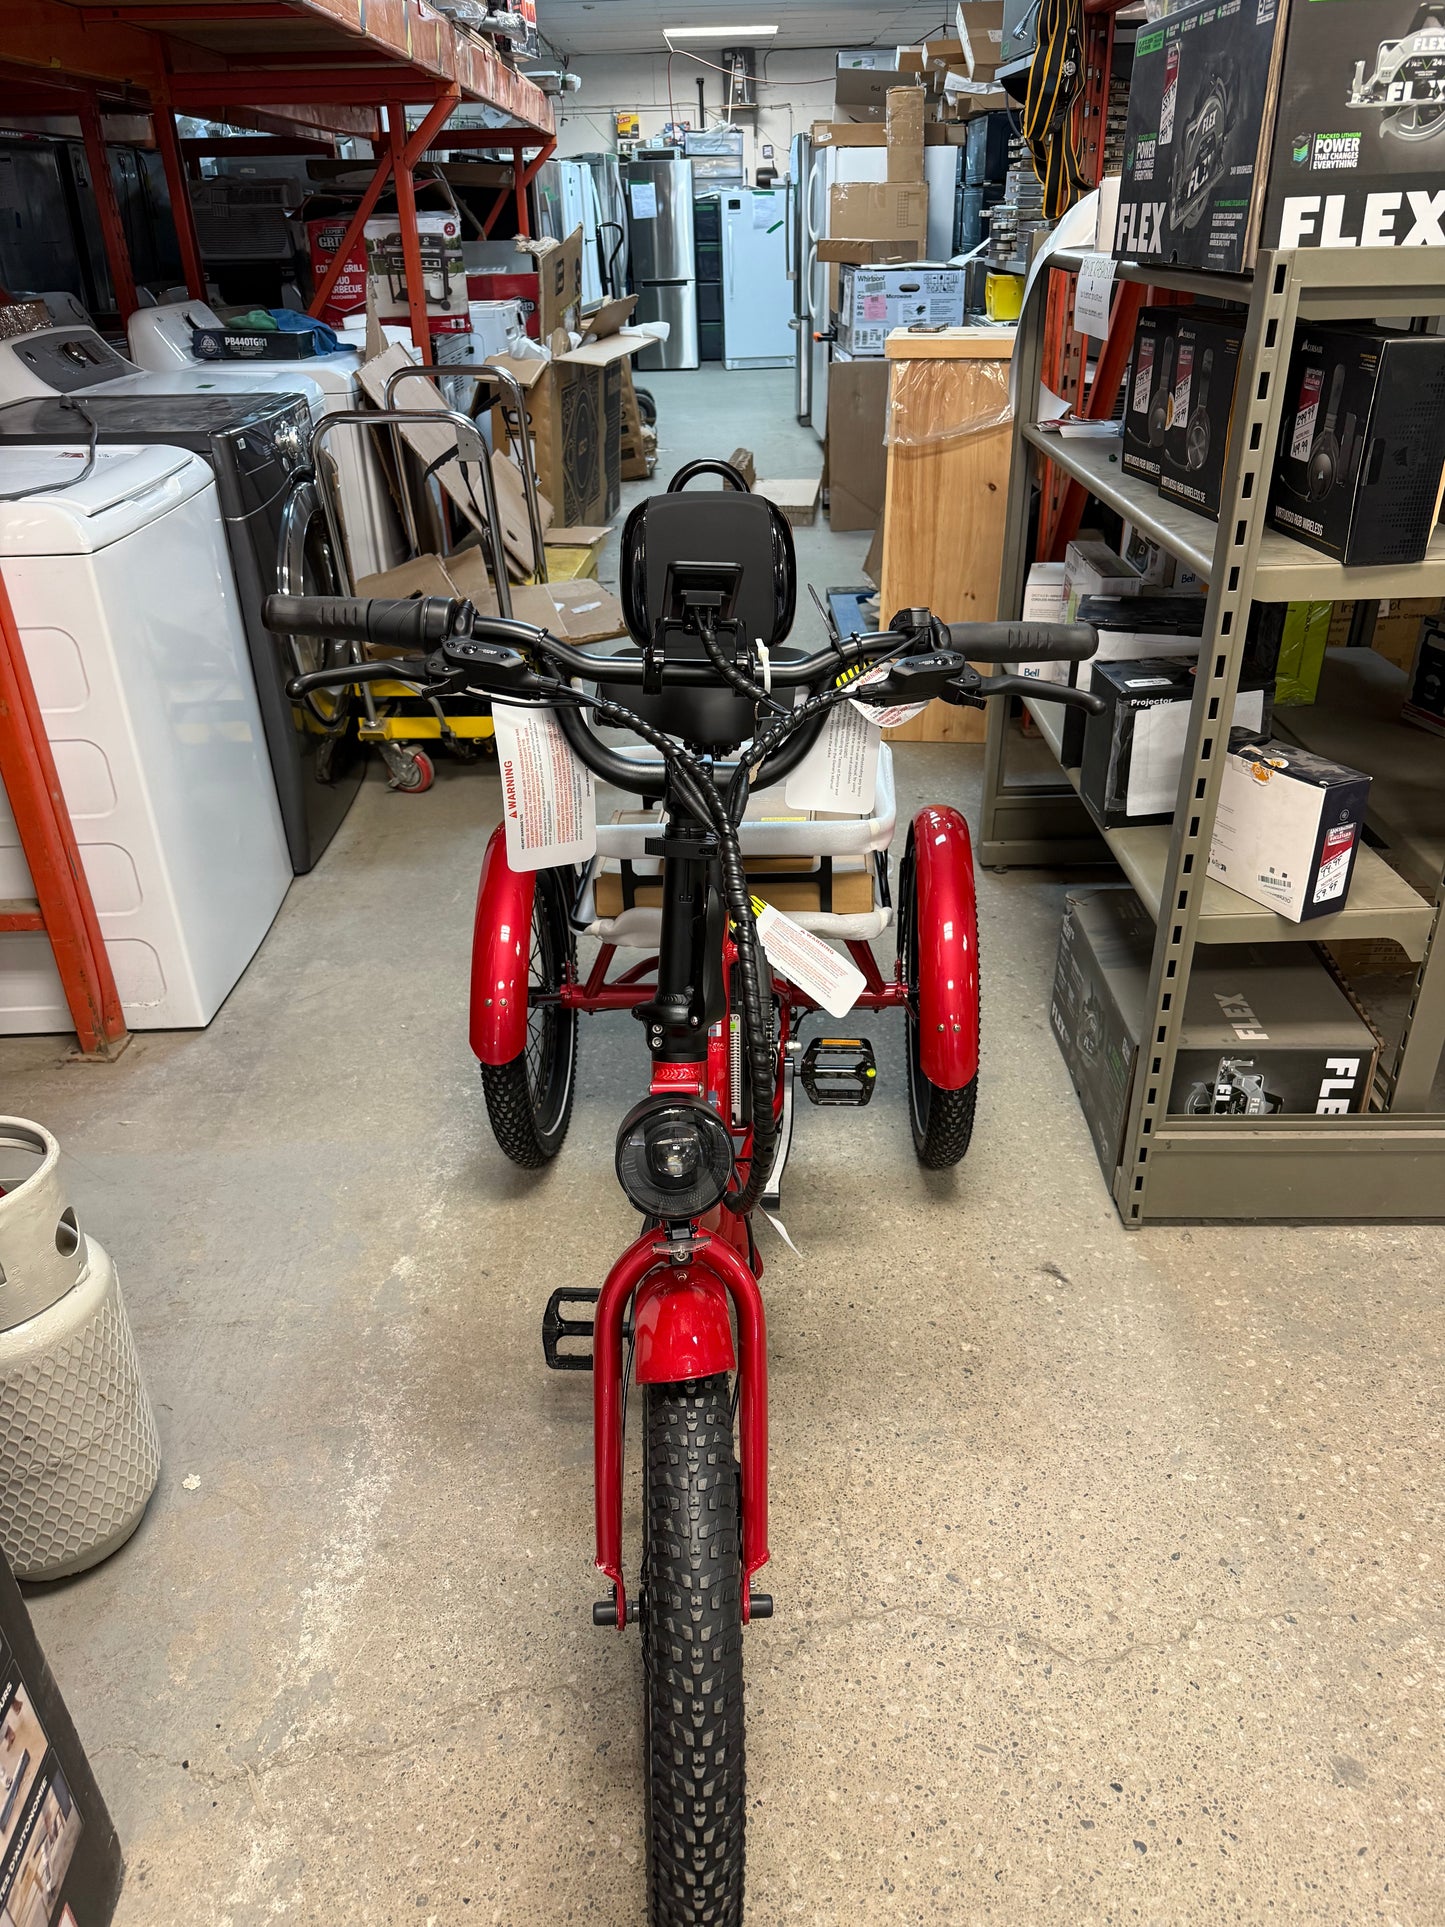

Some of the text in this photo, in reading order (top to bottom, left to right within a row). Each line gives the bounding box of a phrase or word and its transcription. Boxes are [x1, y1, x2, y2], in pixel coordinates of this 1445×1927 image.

[1202, 109, 1218, 134] FLEX
[1136, 140, 1156, 160] POWER
[1315, 138, 1361, 153] POWER
[1312, 159, 1358, 170] EVERYTHING
[1314, 151, 1359, 160] THAT CHANGES
[1116, 202, 1167, 254] FLEX
[1278, 190, 1445, 250] FLEX
[319, 236, 343, 248] GRI
[343, 264, 365, 273] GRILL
[333, 284, 363, 293] RBECUE
[1275, 505, 1294, 524] VIRTUOSO
[1302, 516, 1324, 537] WIRELESS
[1181, 573, 1196, 583] Bell
[861, 668, 883, 684] WARNING
[1024, 668, 1040, 677] Bell
[1130, 697, 1173, 707] Projector
[503, 760, 517, 810] WARNING
[806, 933, 834, 955] WARNING
[1214, 992, 1269, 1040] FLEX
[1315, 1058, 1360, 1114] FLE
[8, 1775, 48, 1871] D'AUTONOMIE
